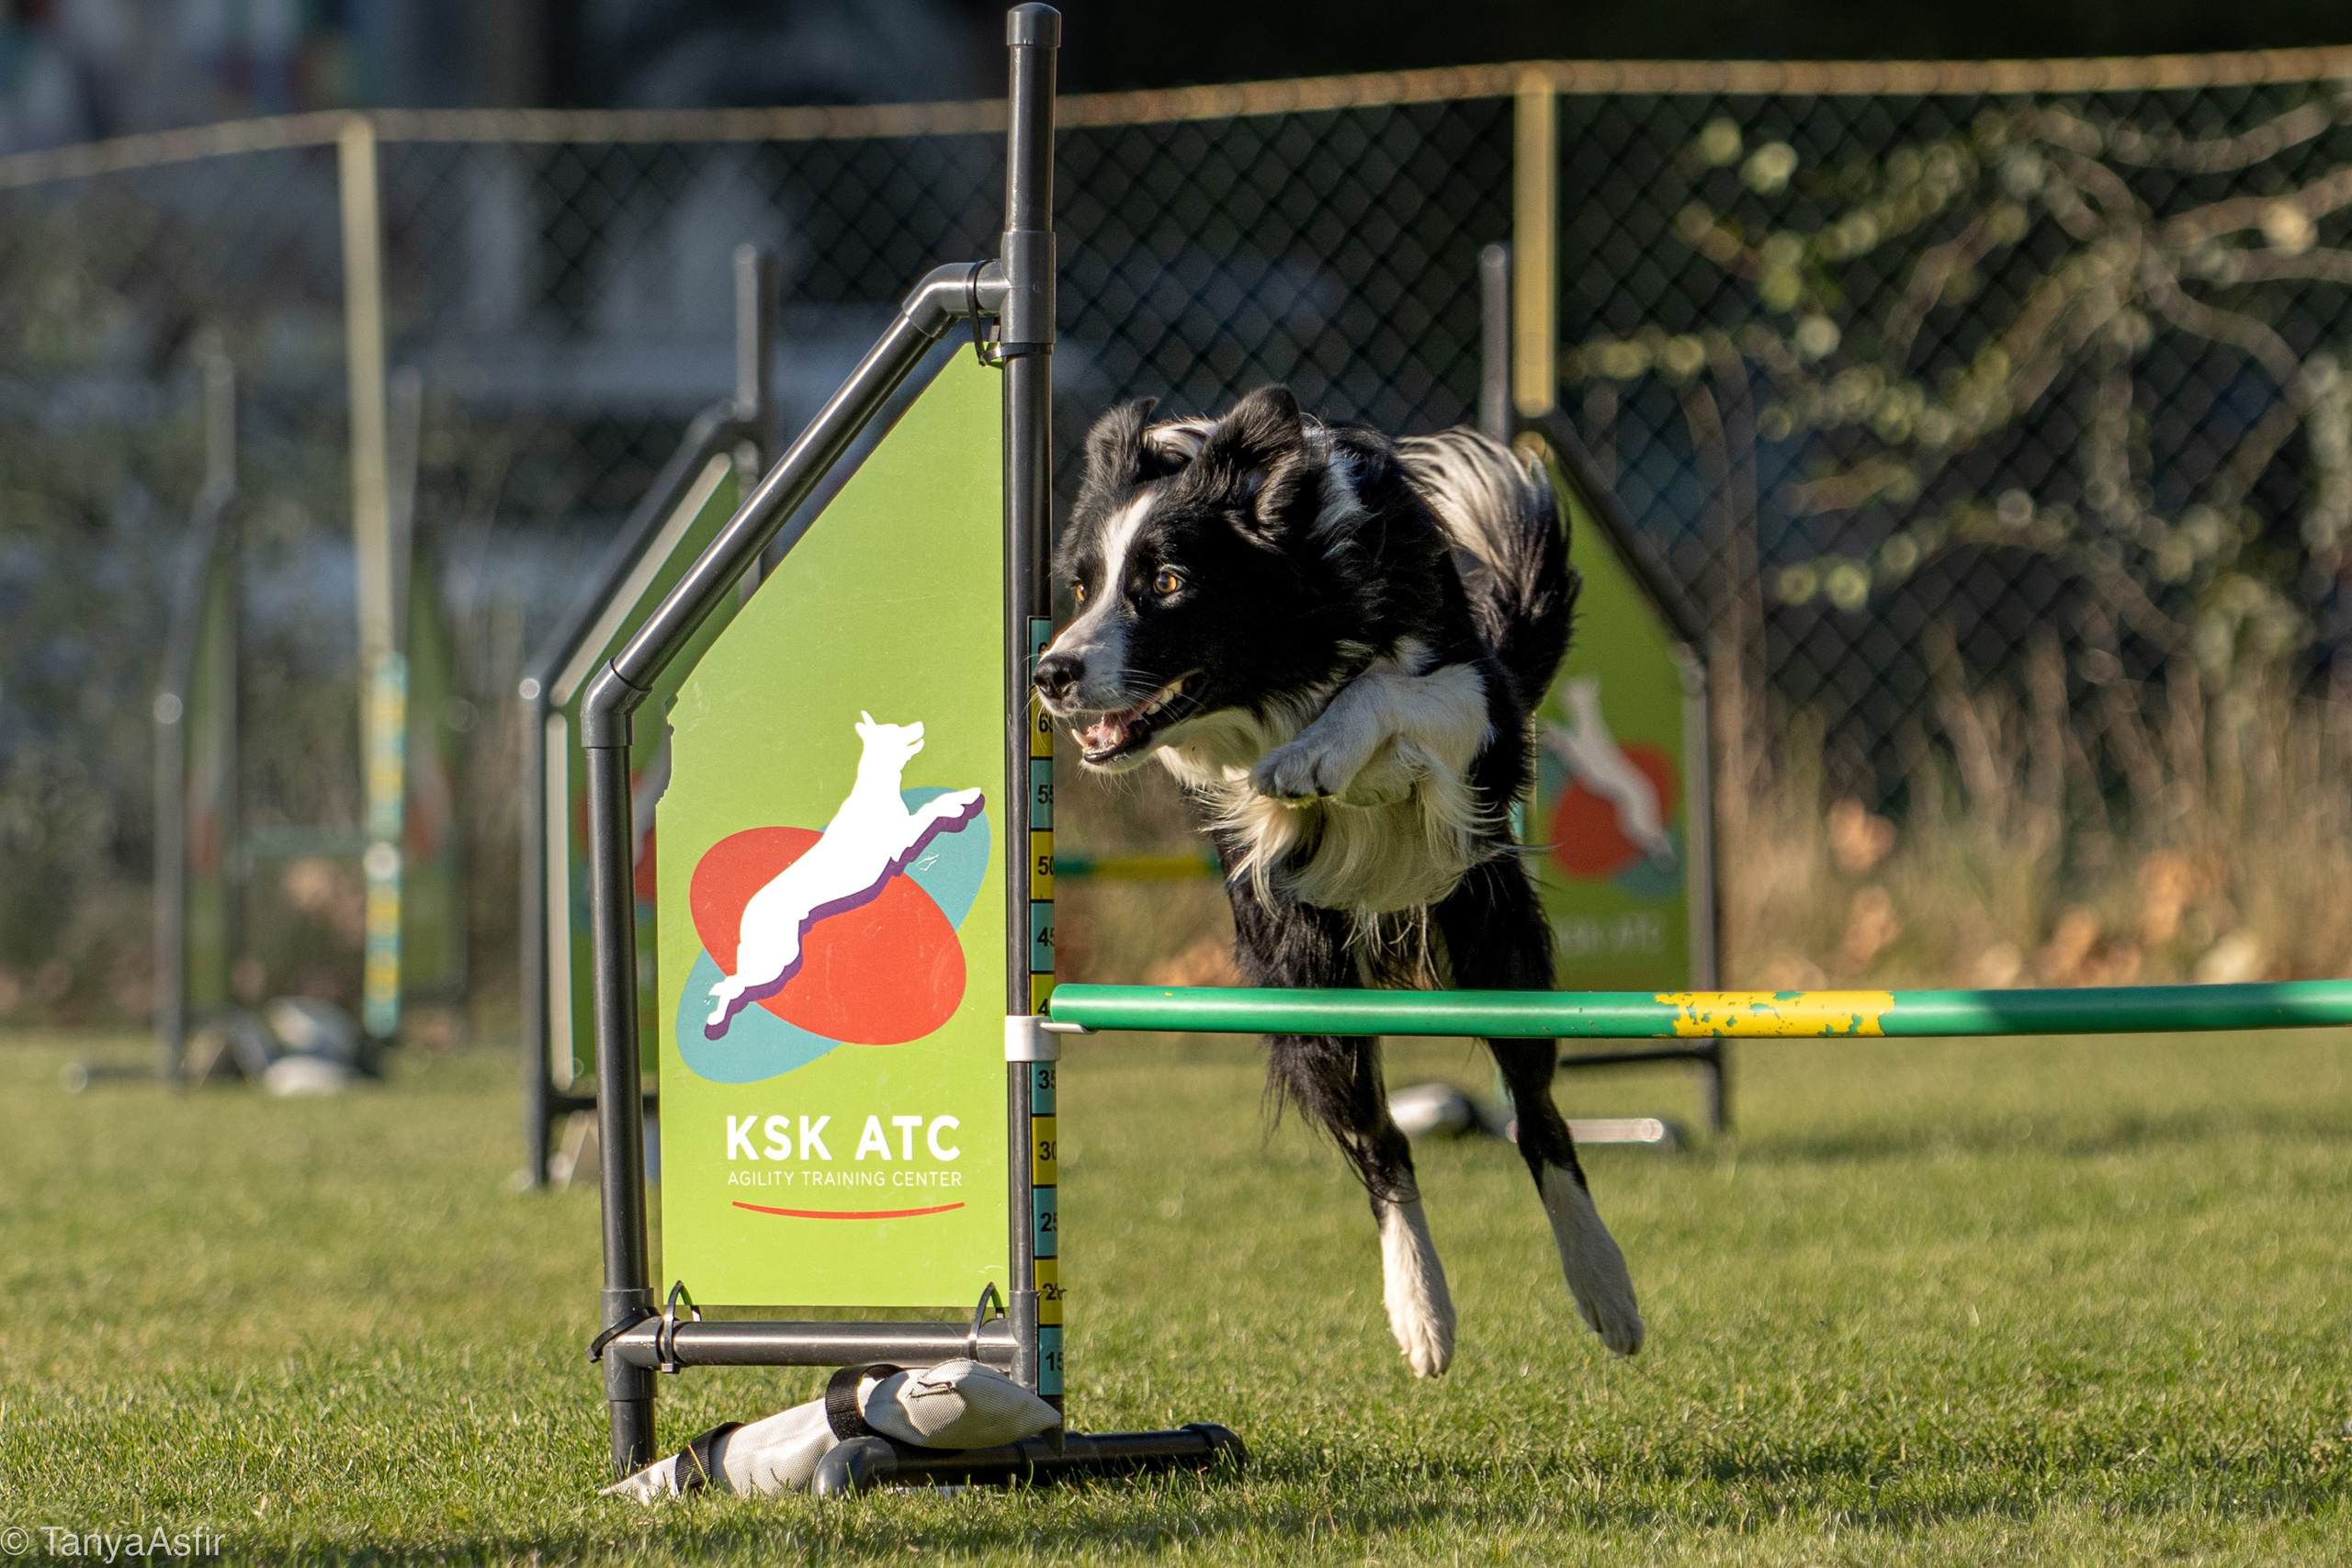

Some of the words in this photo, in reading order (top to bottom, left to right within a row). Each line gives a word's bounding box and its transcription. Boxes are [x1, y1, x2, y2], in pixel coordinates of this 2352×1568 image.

[727, 1115, 832, 1160] KSK
[854, 1115, 961, 1161] ATC
[728, 1171, 795, 1186] AGILITY
[801, 1171, 886, 1186] TRAINING
[892, 1171, 962, 1186] CENTER
